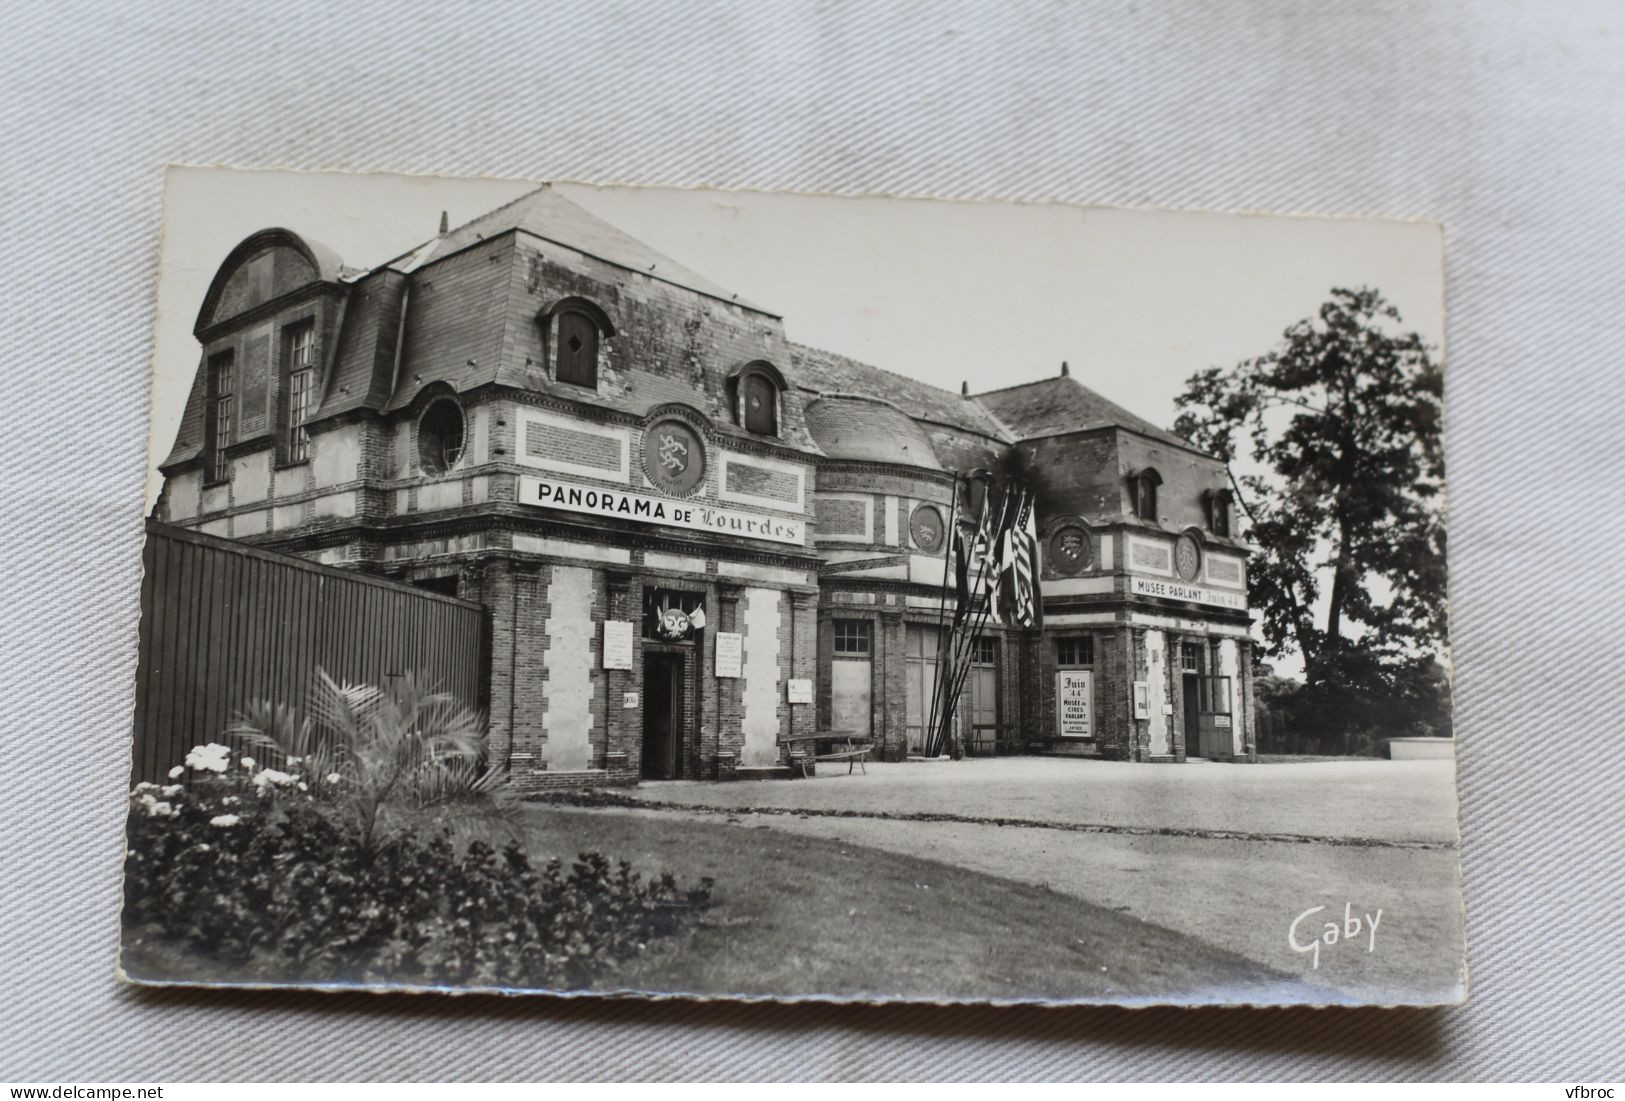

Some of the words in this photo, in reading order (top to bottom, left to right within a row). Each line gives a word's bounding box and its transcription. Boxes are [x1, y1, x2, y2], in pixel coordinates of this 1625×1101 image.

[538, 483, 666, 519] PANORAMA
[674, 509, 691, 523] DE
[1138, 580, 1165, 595] MUSEE
[1169, 585, 1202, 601] PARLANT
[1288, 902, 1383, 970] Gaby
